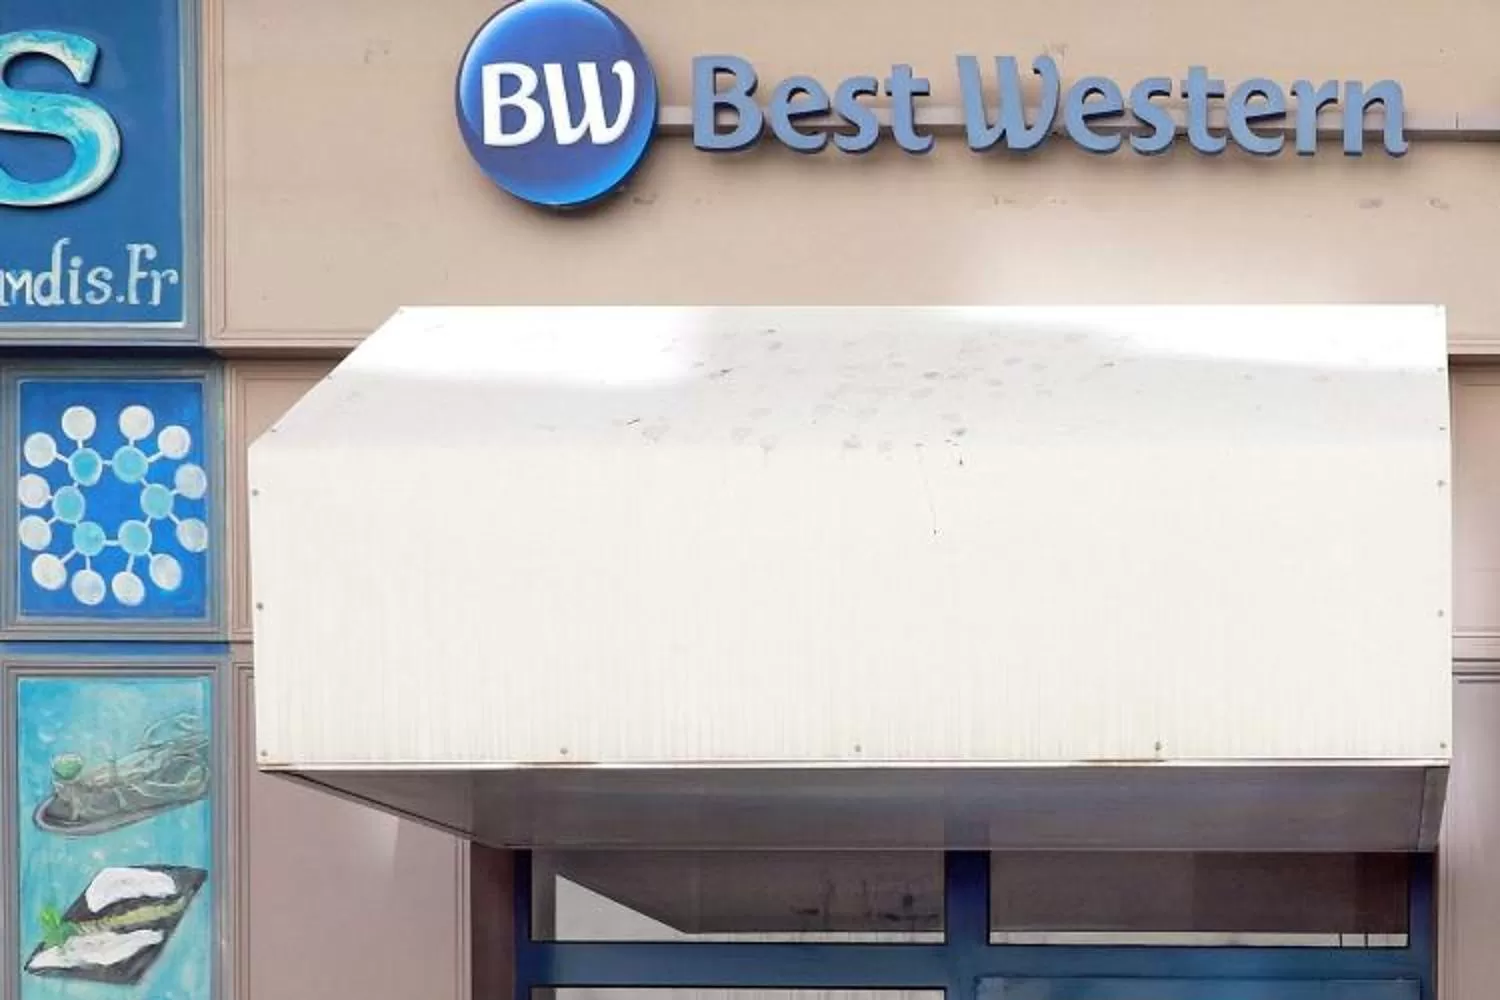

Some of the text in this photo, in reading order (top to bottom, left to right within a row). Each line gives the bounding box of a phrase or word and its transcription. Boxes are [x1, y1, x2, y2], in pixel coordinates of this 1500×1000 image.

[480, 60, 637, 147] BW
[690, 54, 935, 156] Best
[955, 54, 1409, 157] Western
